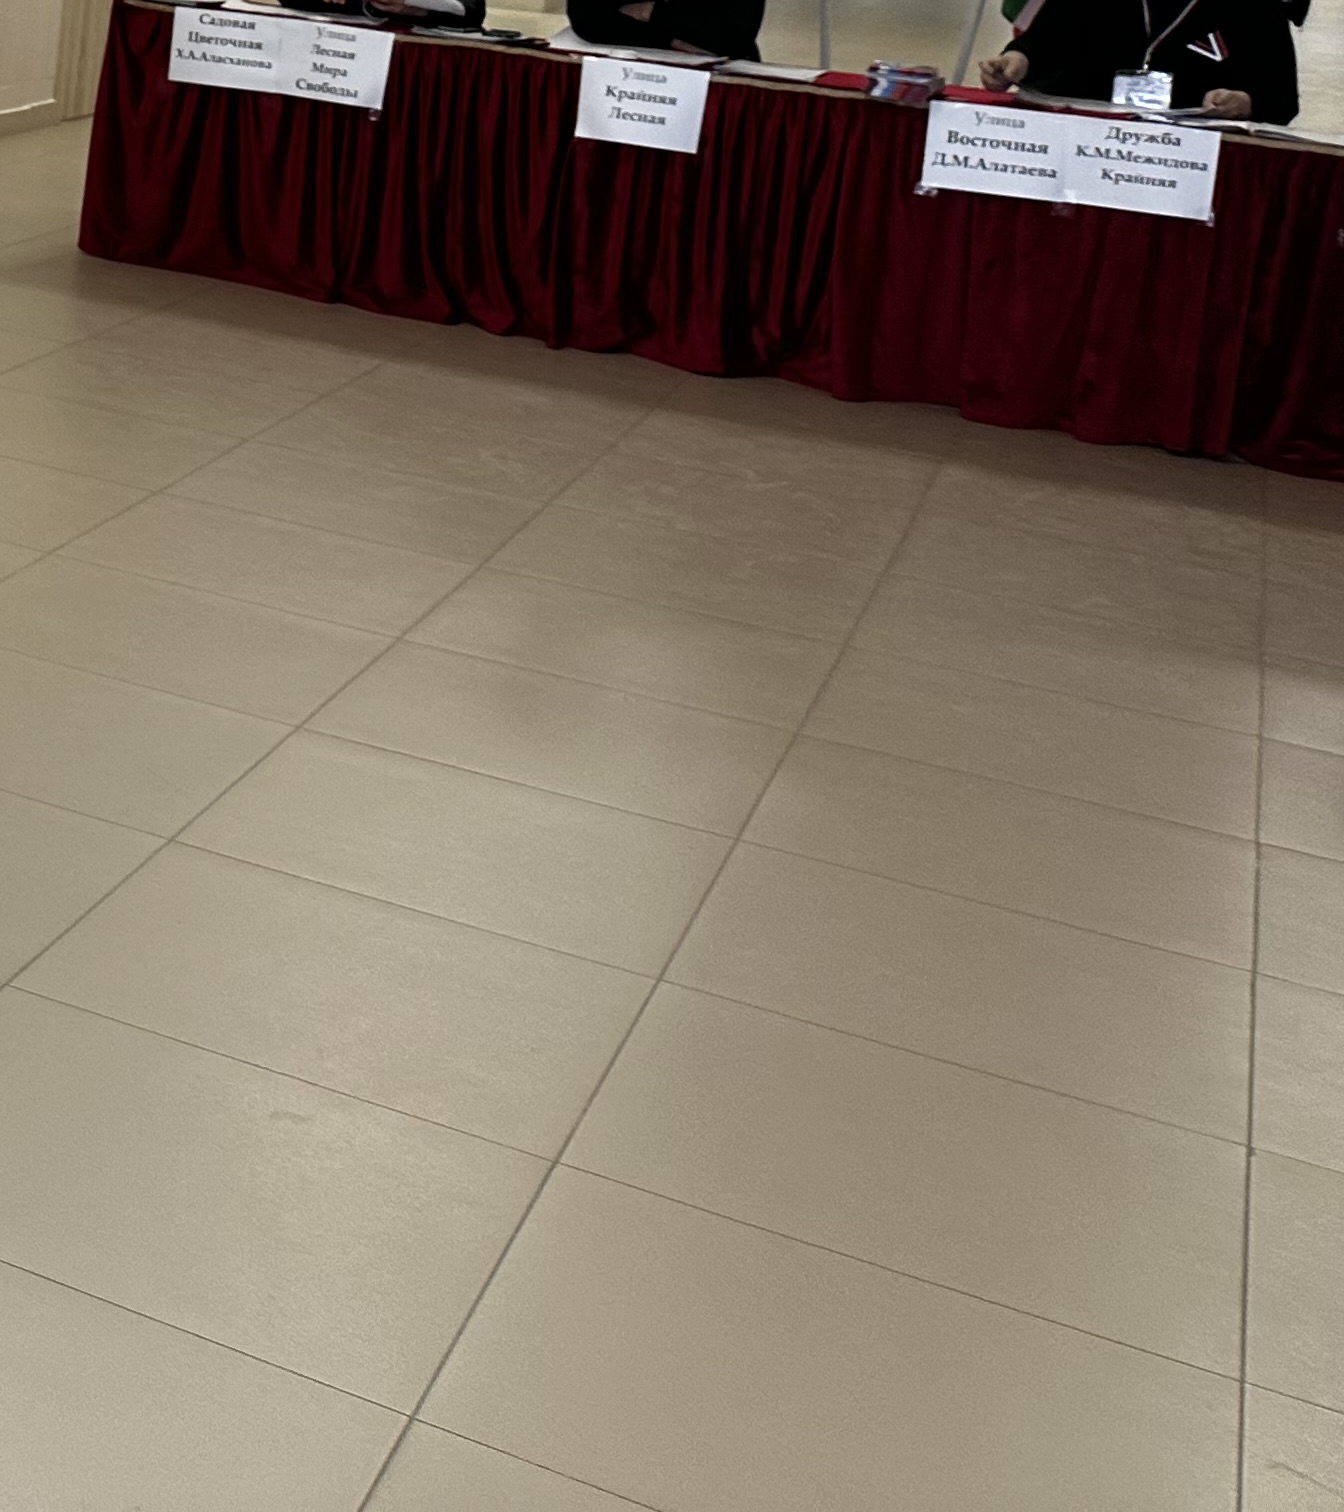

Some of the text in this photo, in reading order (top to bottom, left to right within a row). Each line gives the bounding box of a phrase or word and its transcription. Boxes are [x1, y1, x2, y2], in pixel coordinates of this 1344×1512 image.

[199, 13, 256, 30] Садовая
[187, 31, 263, 50] Цветочная
[295, 78, 358, 98] Свободы
[608, 106, 666, 125] Лесная
[947, 130, 1049, 154] Восточная
[1104, 126, 1182, 147] Дружба
